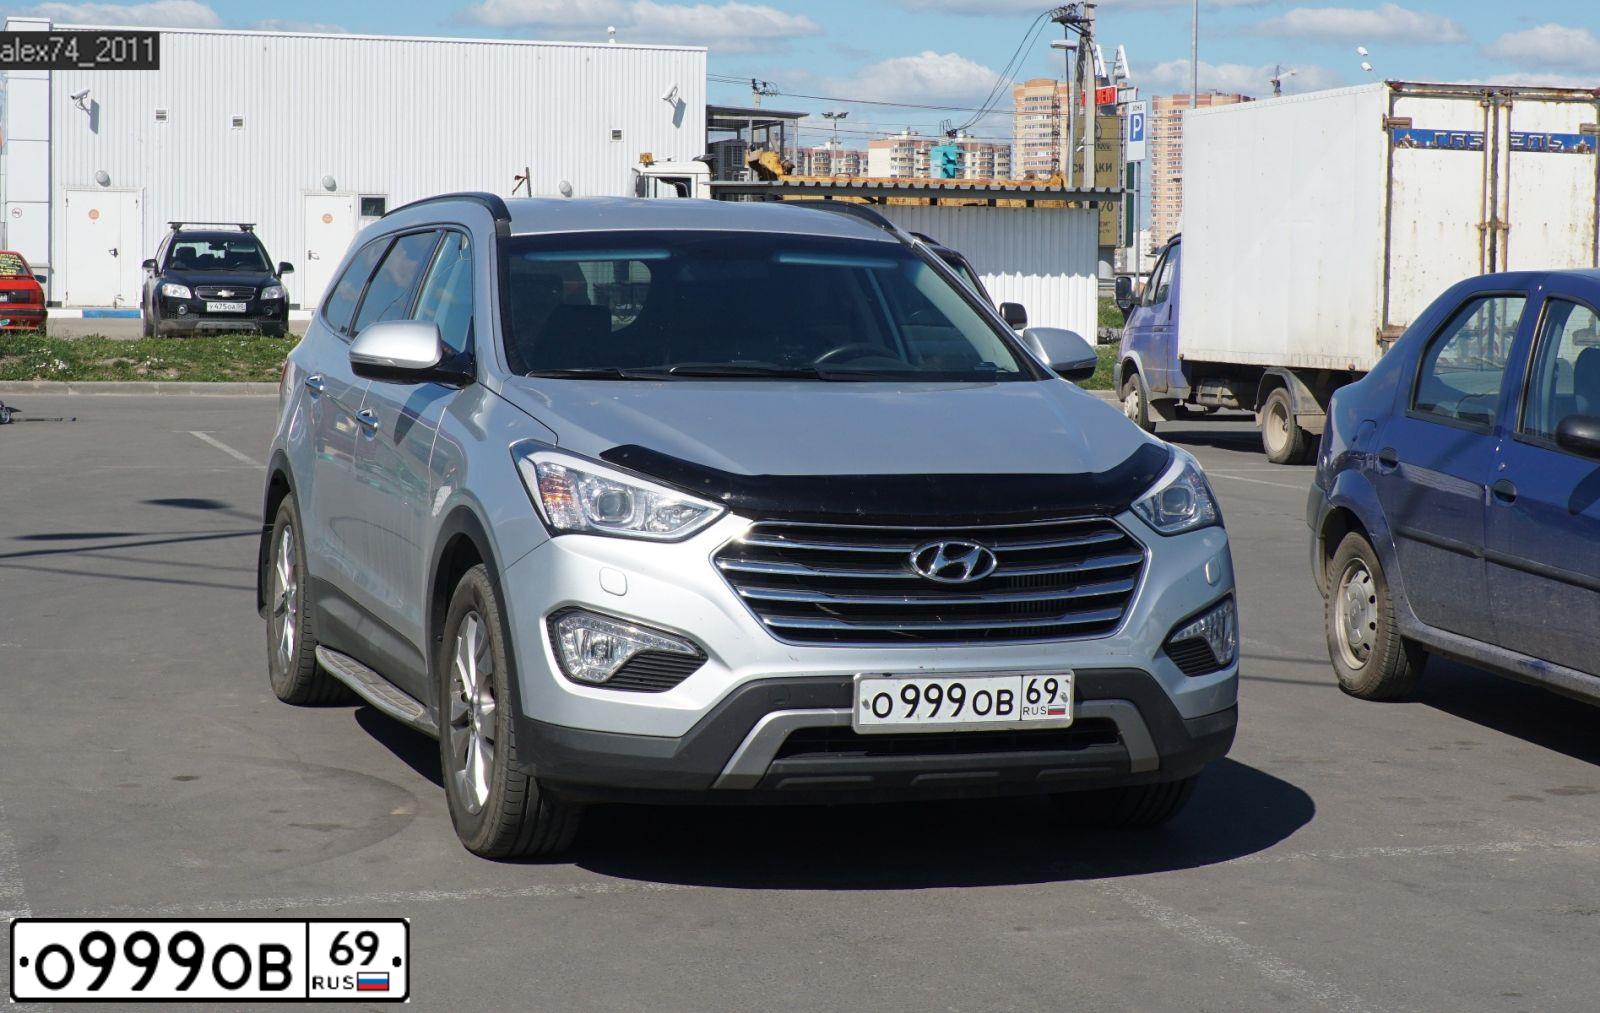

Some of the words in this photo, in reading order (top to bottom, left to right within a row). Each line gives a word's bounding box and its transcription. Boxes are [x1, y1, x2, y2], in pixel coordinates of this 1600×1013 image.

[1133, 115, 1142, 140] P
[871, 682, 1014, 719] О999ОВ
[1025, 677, 1059, 704] 69
[1022, 704, 1047, 716] RUS
